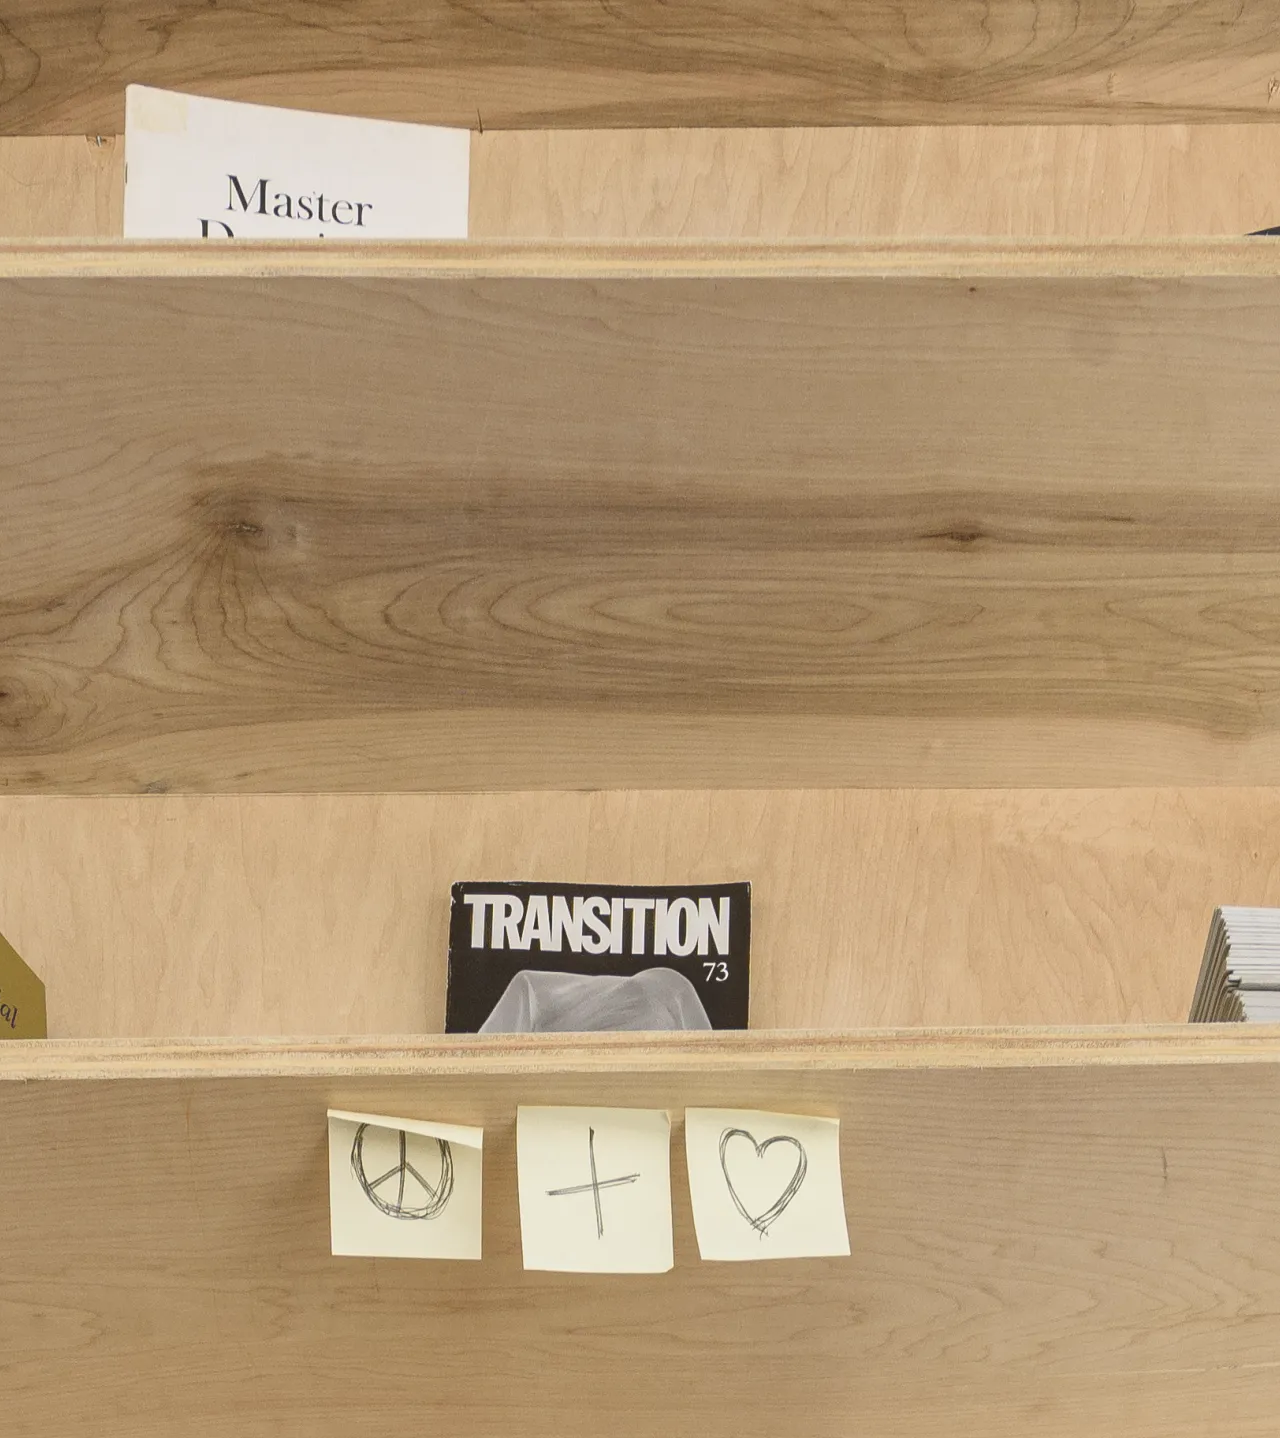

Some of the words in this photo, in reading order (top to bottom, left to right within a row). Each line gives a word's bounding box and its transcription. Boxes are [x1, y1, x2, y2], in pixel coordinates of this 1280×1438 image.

[226, 173, 373, 227] Master
[464, 893, 730, 957] TRANSITION
[702, 962, 729, 982] 73
